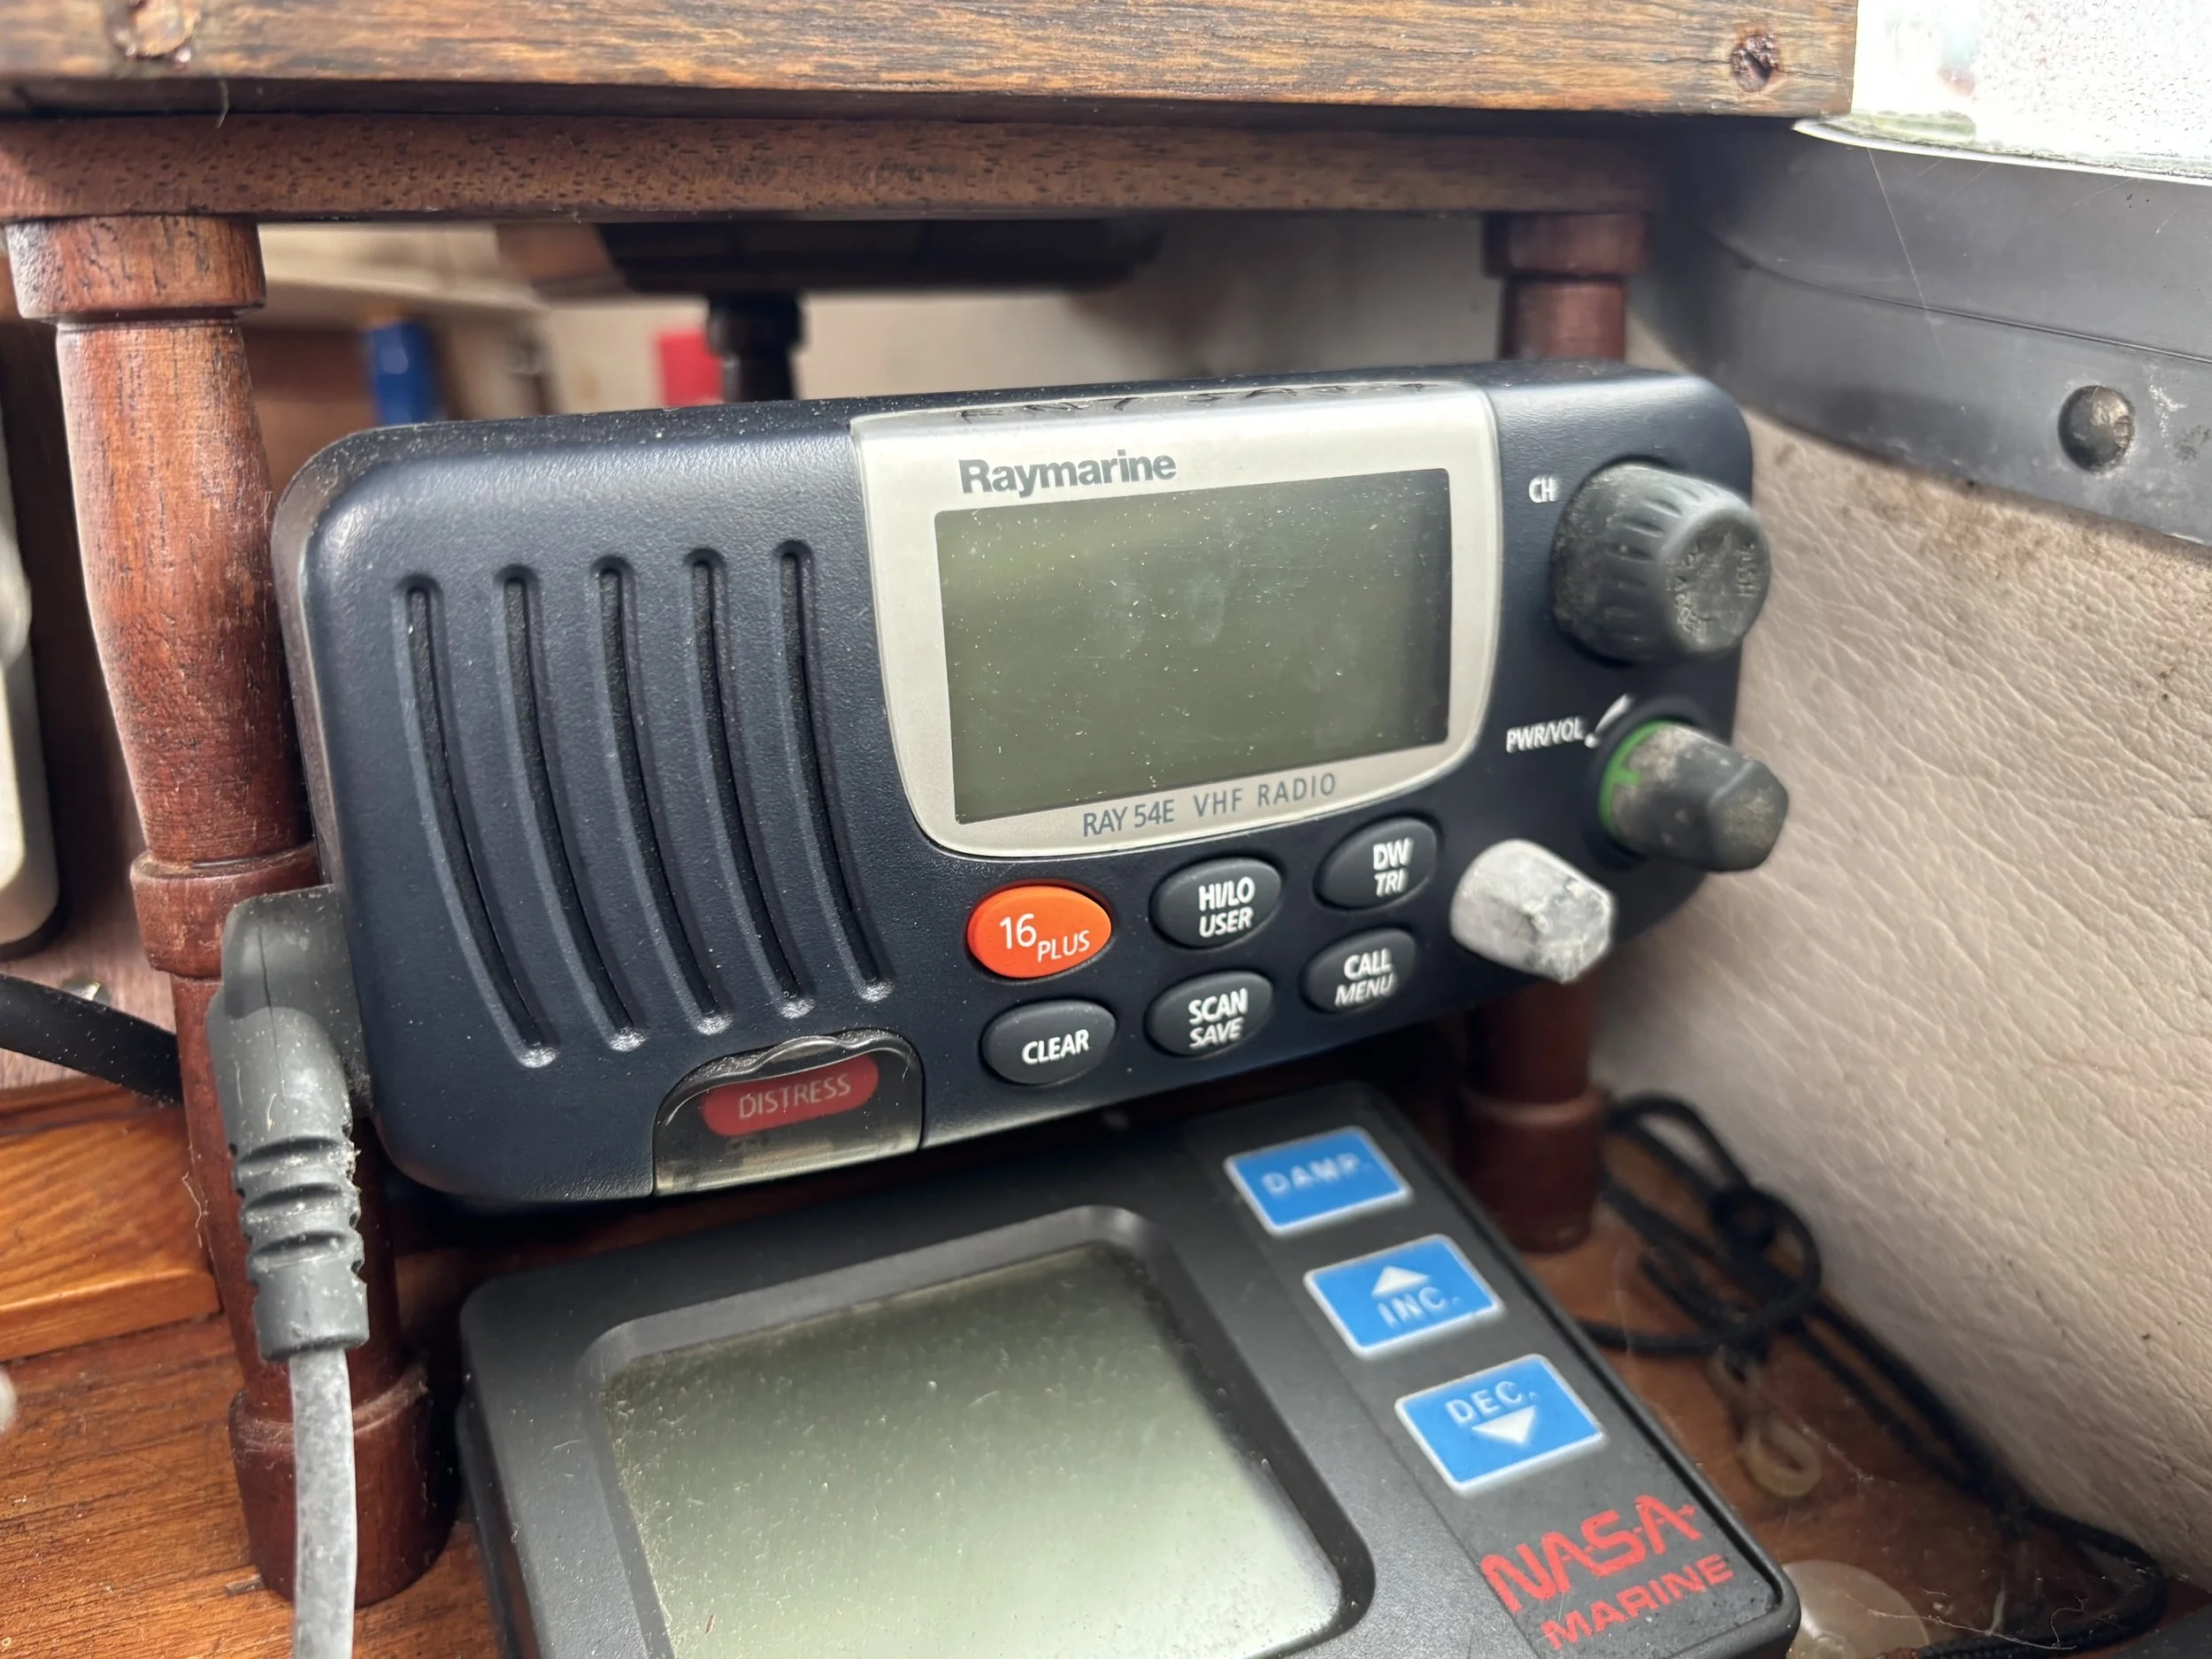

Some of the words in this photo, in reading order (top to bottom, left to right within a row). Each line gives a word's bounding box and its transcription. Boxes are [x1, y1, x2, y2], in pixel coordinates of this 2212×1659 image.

[959, 449, 1177, 498] Raymarine
[1528, 476, 1559, 503] CH
[1505, 718, 1586, 753] PWR/VOL
[1083, 806, 1128, 837] RAY
[1133, 799, 1175, 828] 54E
[1193, 787, 1243, 818] VHF
[1257, 772, 1336, 808] RADIO
[1372, 837, 1411, 872] DW
[1198, 876, 1255, 912] HI/LO
[1374, 868, 1404, 897] TRI
[1000, 913, 1036, 949] 16
[1036, 930, 1090, 964] PLUS
[1199, 906, 1252, 938] USER
[1344, 948, 1392, 979] CALL
[1187, 987, 1248, 1025] SCAN
[1334, 973, 1394, 1008] MENU
[1021, 1028, 1089, 1065] CLEAR
[1189, 1017, 1242, 1048] SAVE
[738, 1072, 851, 1119] DISTRESS
[1377, 1286, 1463, 1328] INC.
[1444, 1380, 1538, 1425] DEC.
[1480, 1494, 1702, 1612] NASA
[1540, 1554, 1734, 1649] MARINE
